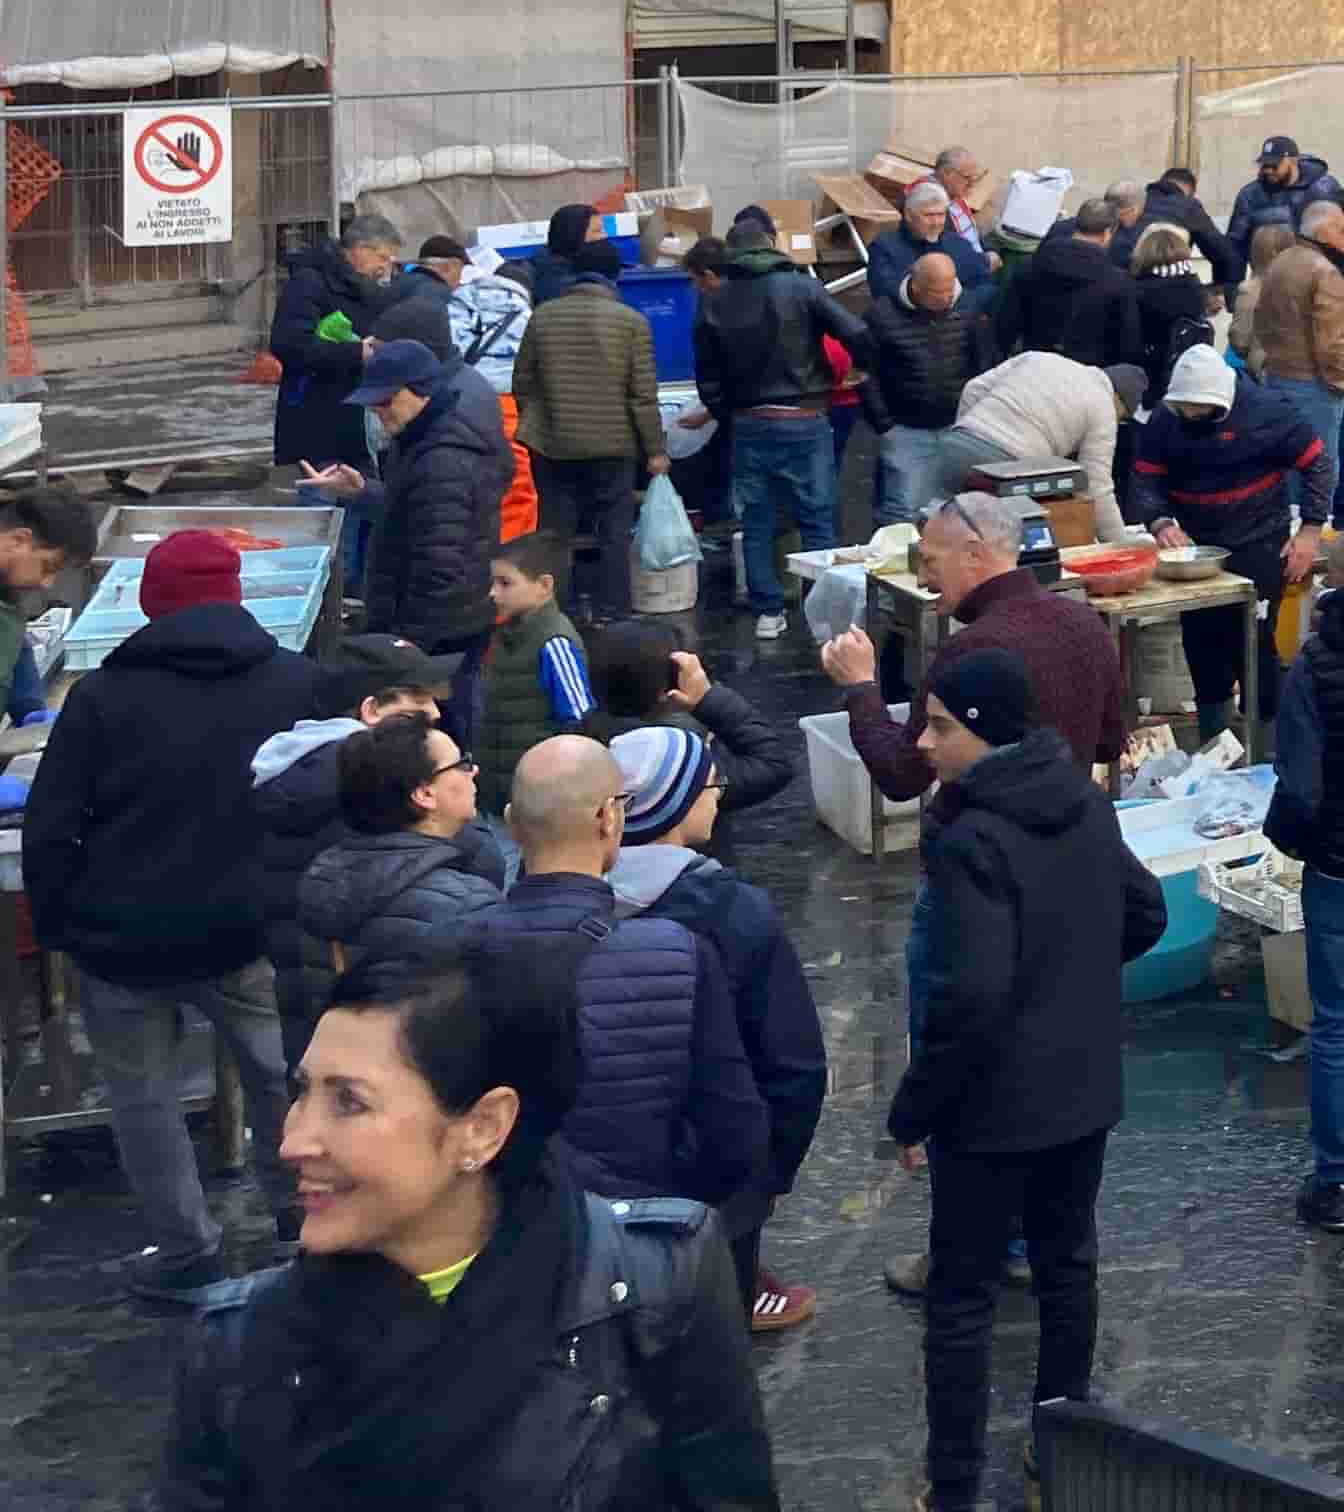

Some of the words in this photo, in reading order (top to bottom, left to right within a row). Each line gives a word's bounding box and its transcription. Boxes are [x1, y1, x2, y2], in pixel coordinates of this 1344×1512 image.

[158, 198, 201, 209] VIETATO
[147, 207, 211, 219] L'INGRESSO
[136, 221, 147, 230] AI
[150, 219, 173, 229] NON
[176, 216, 222, 227] ADDETTI
